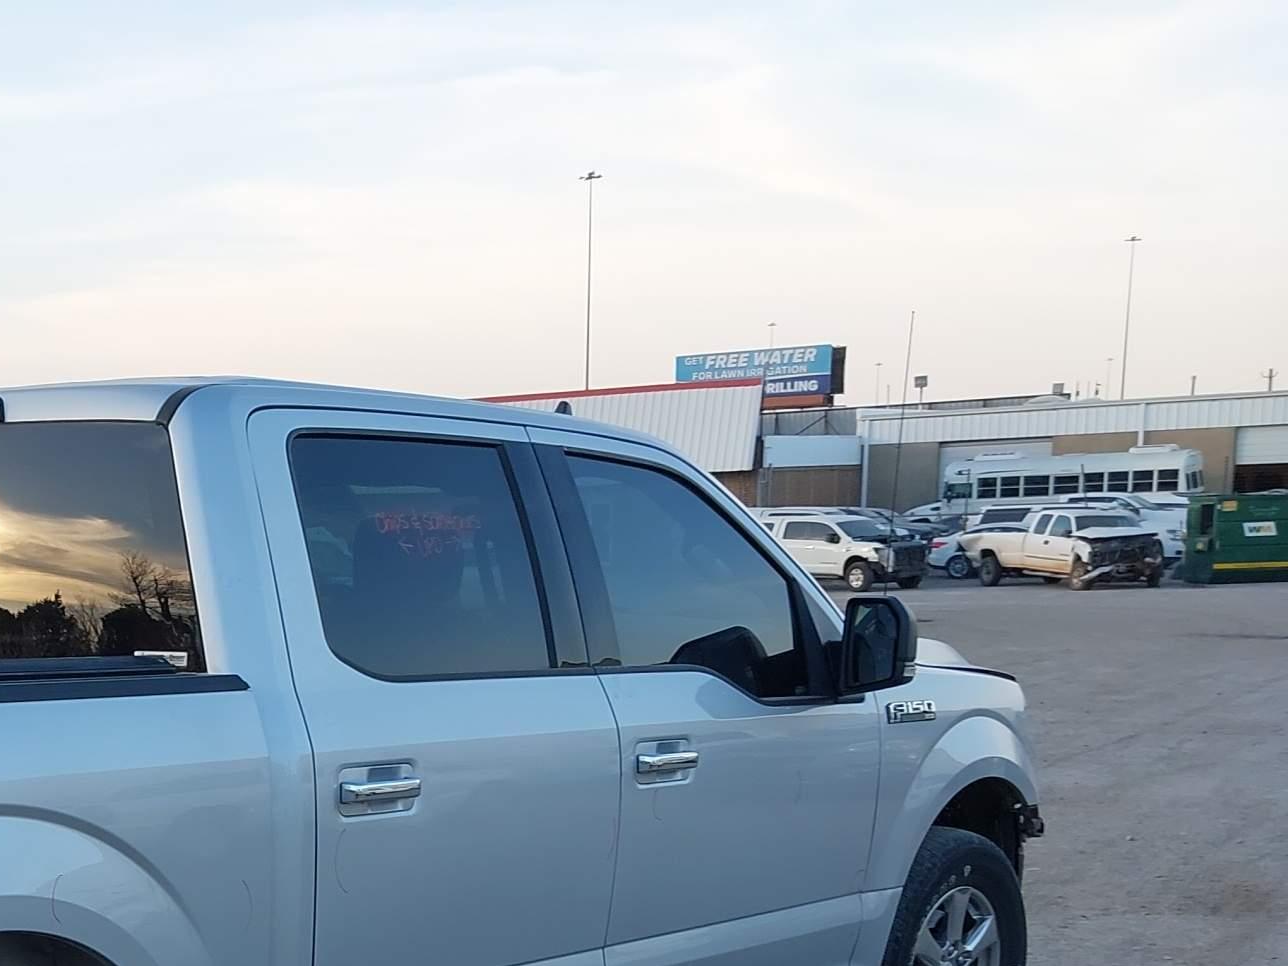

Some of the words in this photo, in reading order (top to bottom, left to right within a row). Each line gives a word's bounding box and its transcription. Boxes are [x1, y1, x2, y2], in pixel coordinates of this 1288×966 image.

[684, 356, 704, 366] GET
[704, 352, 750, 369] FREE
[753, 348, 817, 366] WATER
[692, 371, 712, 381] FOR
[714, 369, 744, 380] LAWN
[746, 365, 808, 378] IRRGATION
[765, 380, 819, 394] RILLING
